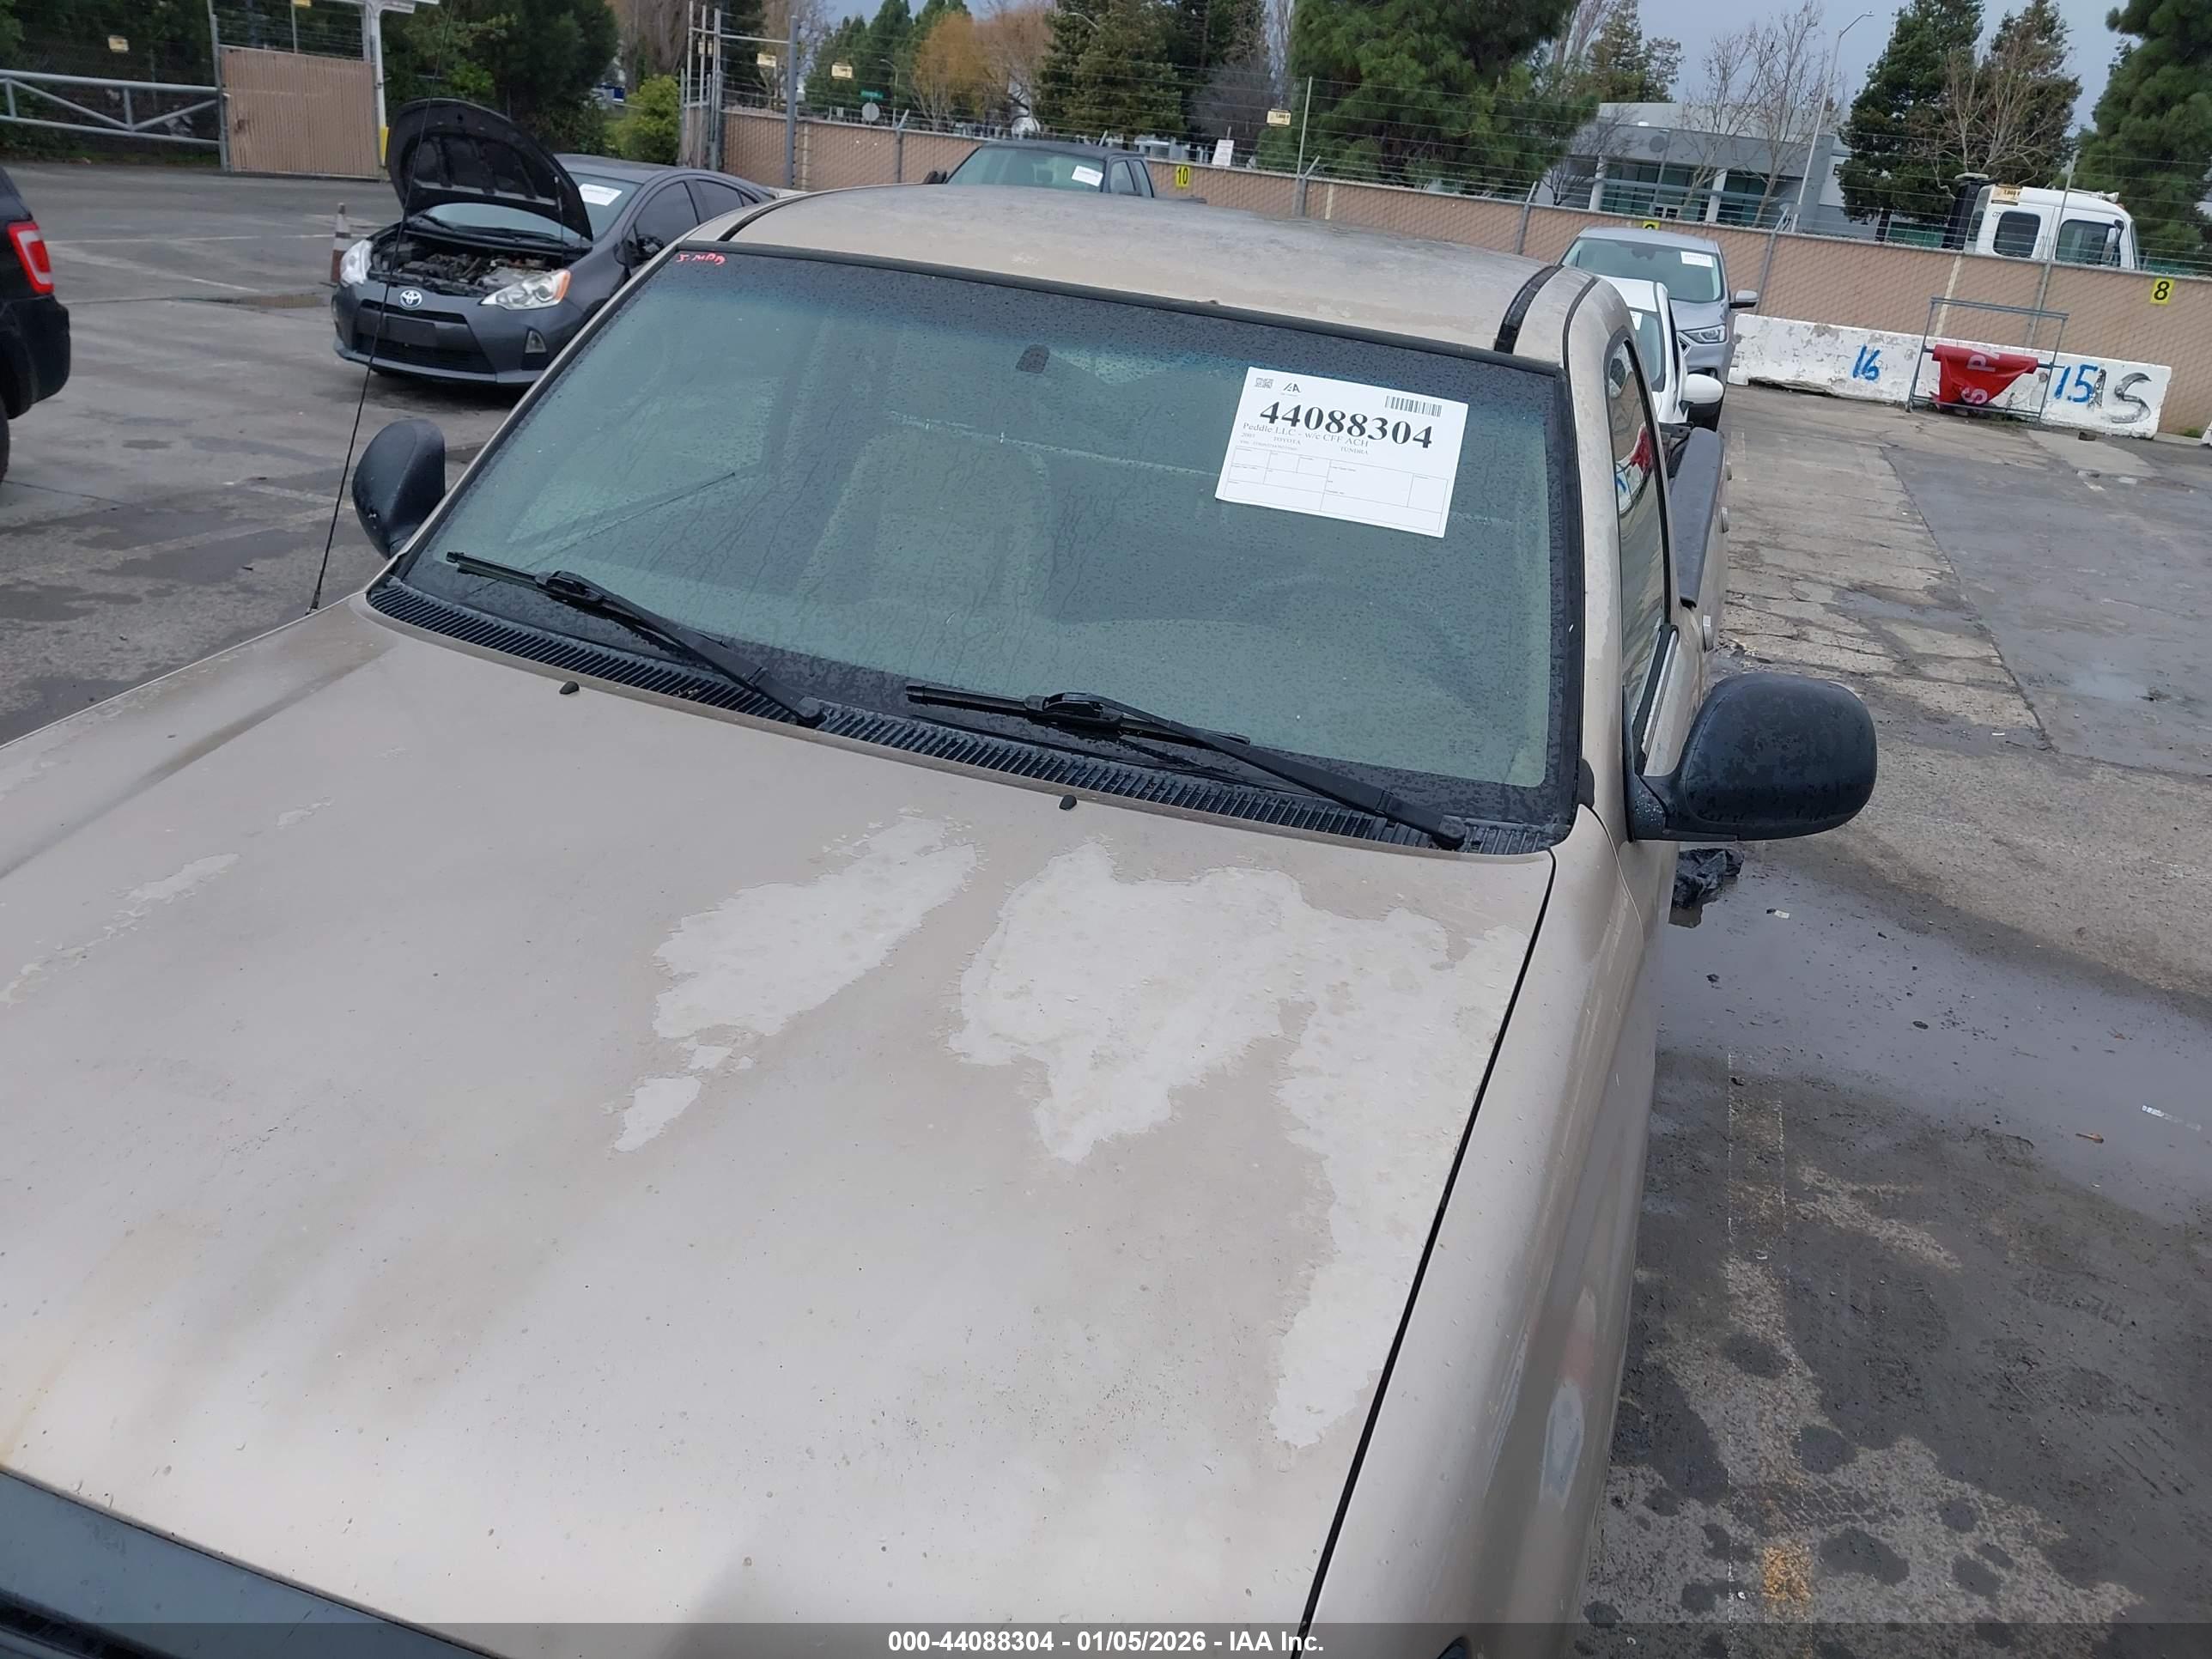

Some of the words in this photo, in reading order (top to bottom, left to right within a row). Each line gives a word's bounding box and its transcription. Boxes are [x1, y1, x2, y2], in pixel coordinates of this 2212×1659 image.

[1177, 167, 1188, 185] 10
[2154, 280, 2170, 301] 8
[1852, 345, 1881, 381] 16
[2054, 364, 2098, 403] 15
[1243, 422, 1272, 433] Peddle
[1275, 426, 1297, 436] LLC
[1345, 437, 1369, 447] ACH
[1260, 401, 1432, 448] 44088304
